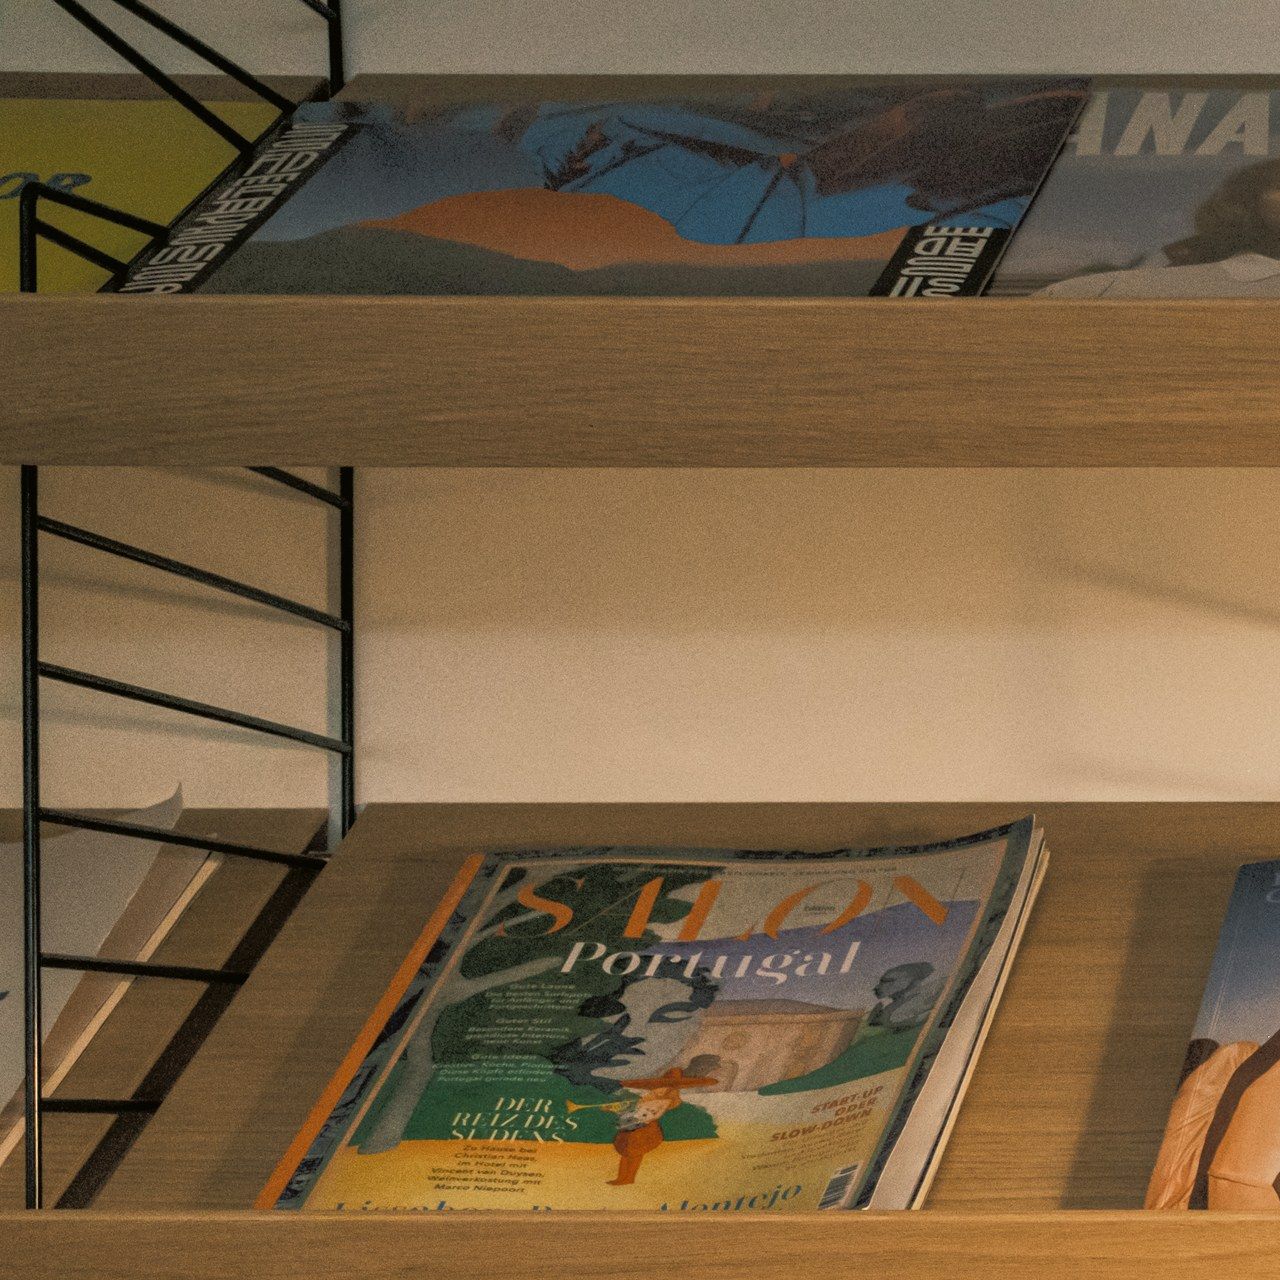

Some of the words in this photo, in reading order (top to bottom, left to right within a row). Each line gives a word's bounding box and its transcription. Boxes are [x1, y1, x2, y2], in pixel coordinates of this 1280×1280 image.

[560, 940, 861, 986] Portugal
[494, 1096, 554, 1113] DER
[834, 1097, 878, 1118] ODER
